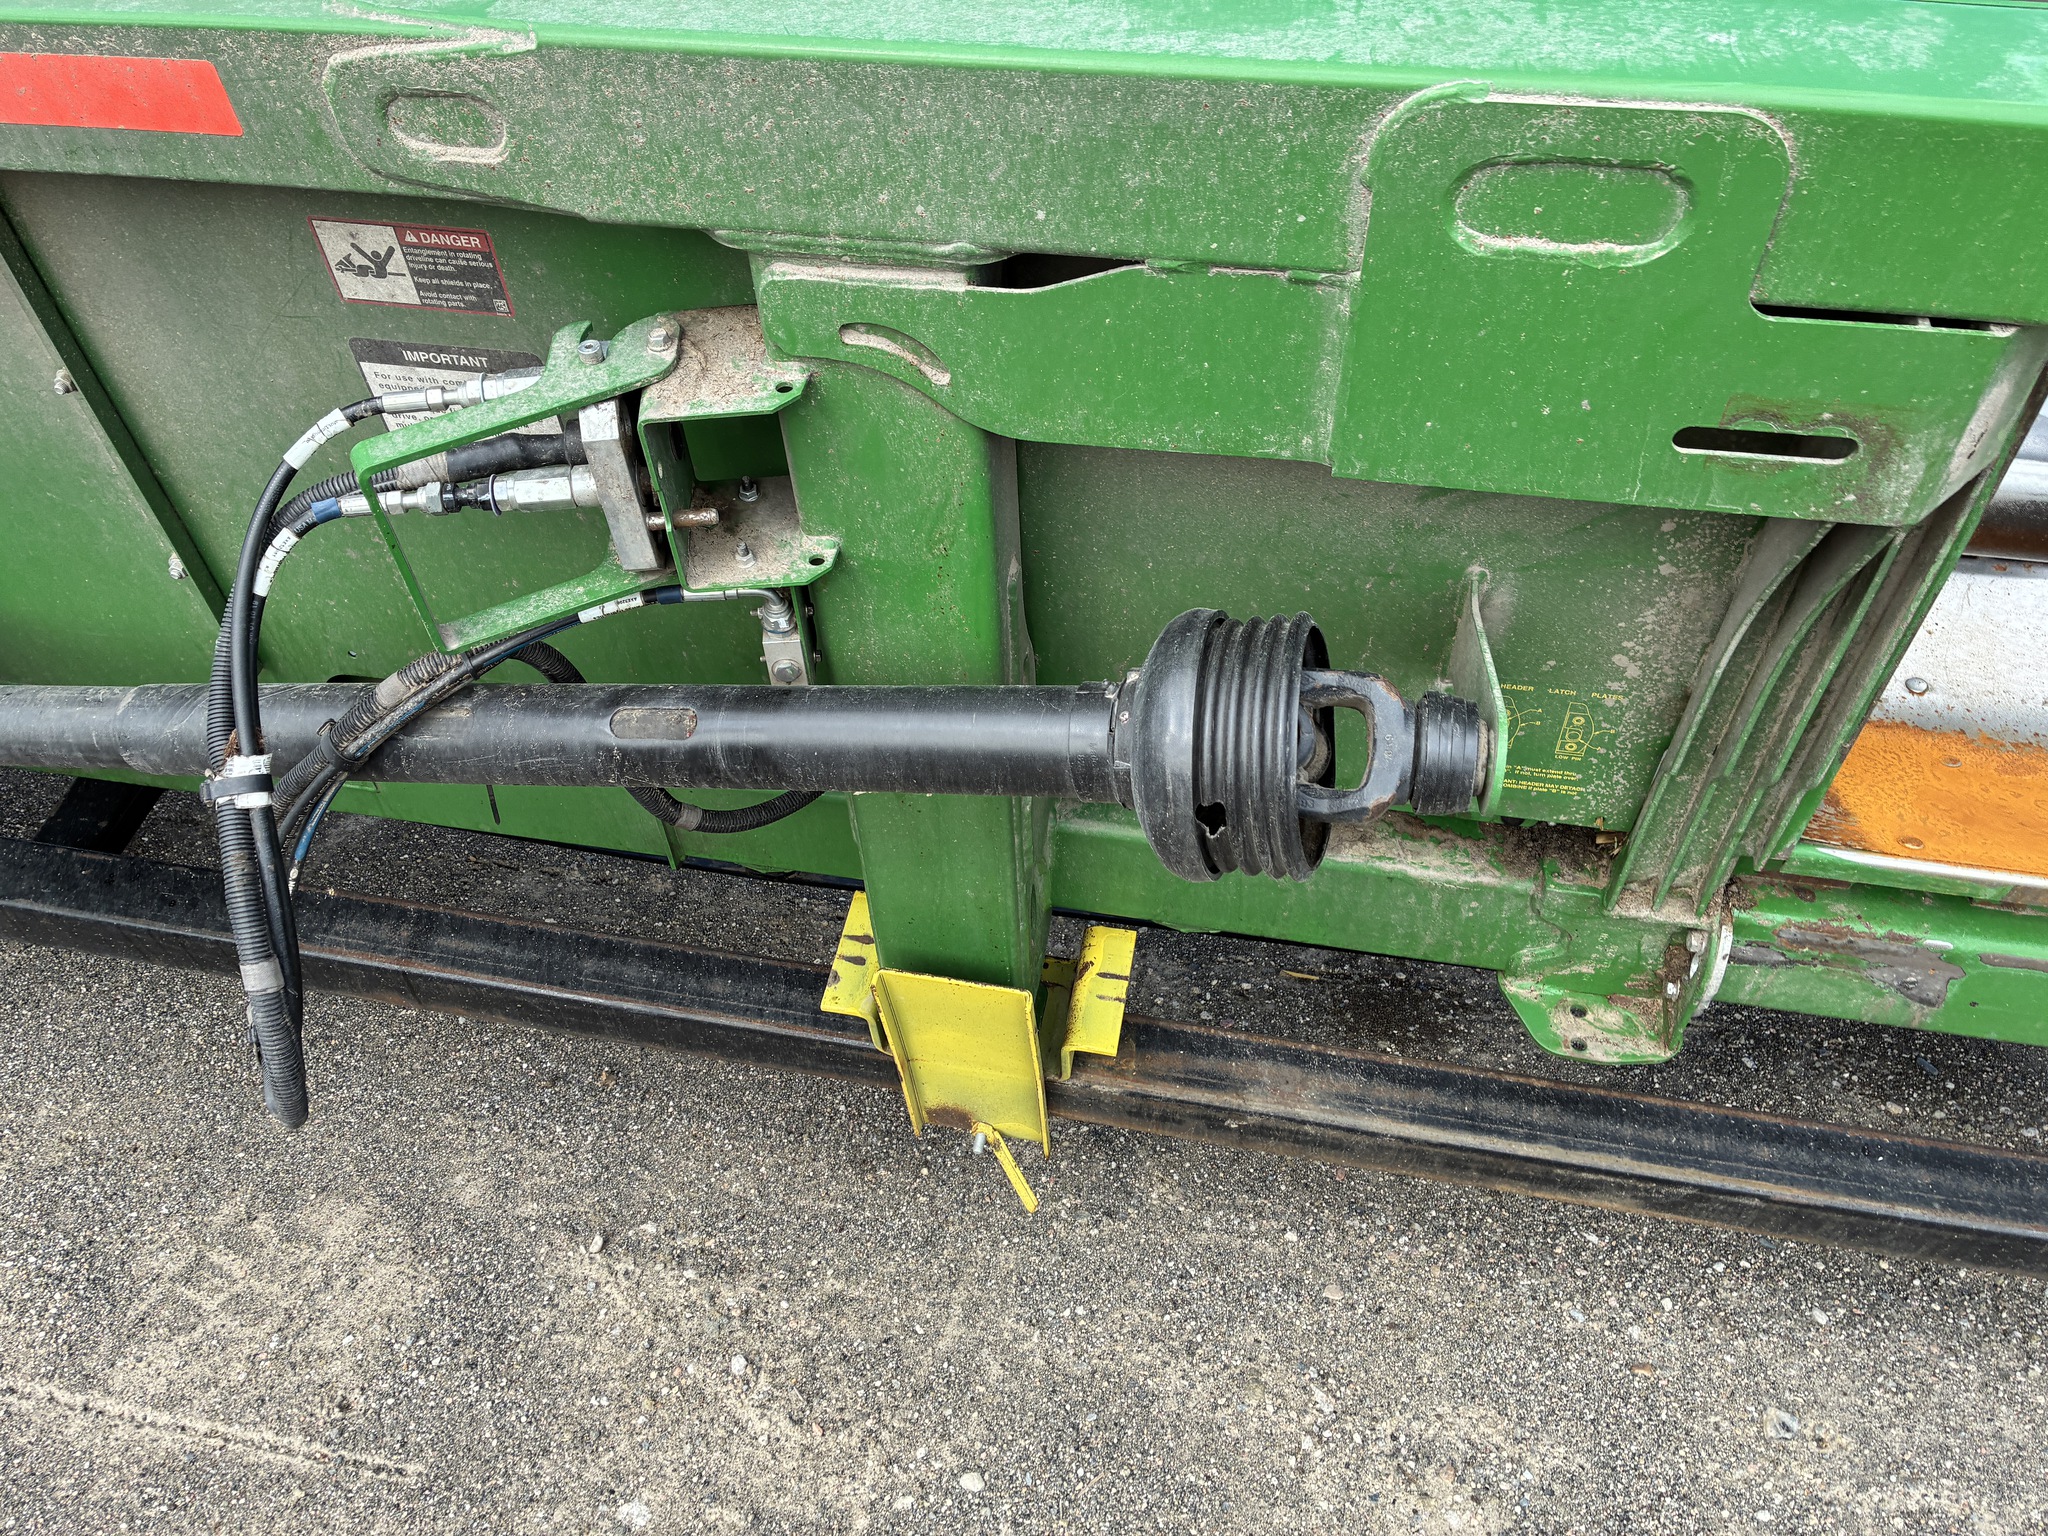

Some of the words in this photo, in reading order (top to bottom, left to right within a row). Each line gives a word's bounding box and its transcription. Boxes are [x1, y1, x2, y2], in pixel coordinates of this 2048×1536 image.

[420, 232, 482, 248] DANGER
[403, 247, 448, 257] Entanglement
[406, 255, 434, 263] driveline
[409, 262, 427, 270] injury
[414, 276, 431, 284] Keep
[402, 350, 488, 368] IMPORTANT
[374, 372, 391, 380] For
[417, 376, 440, 384] with
[294, 522, 308, 533] USA
[1500, 684, 1535, 692] HEADER
